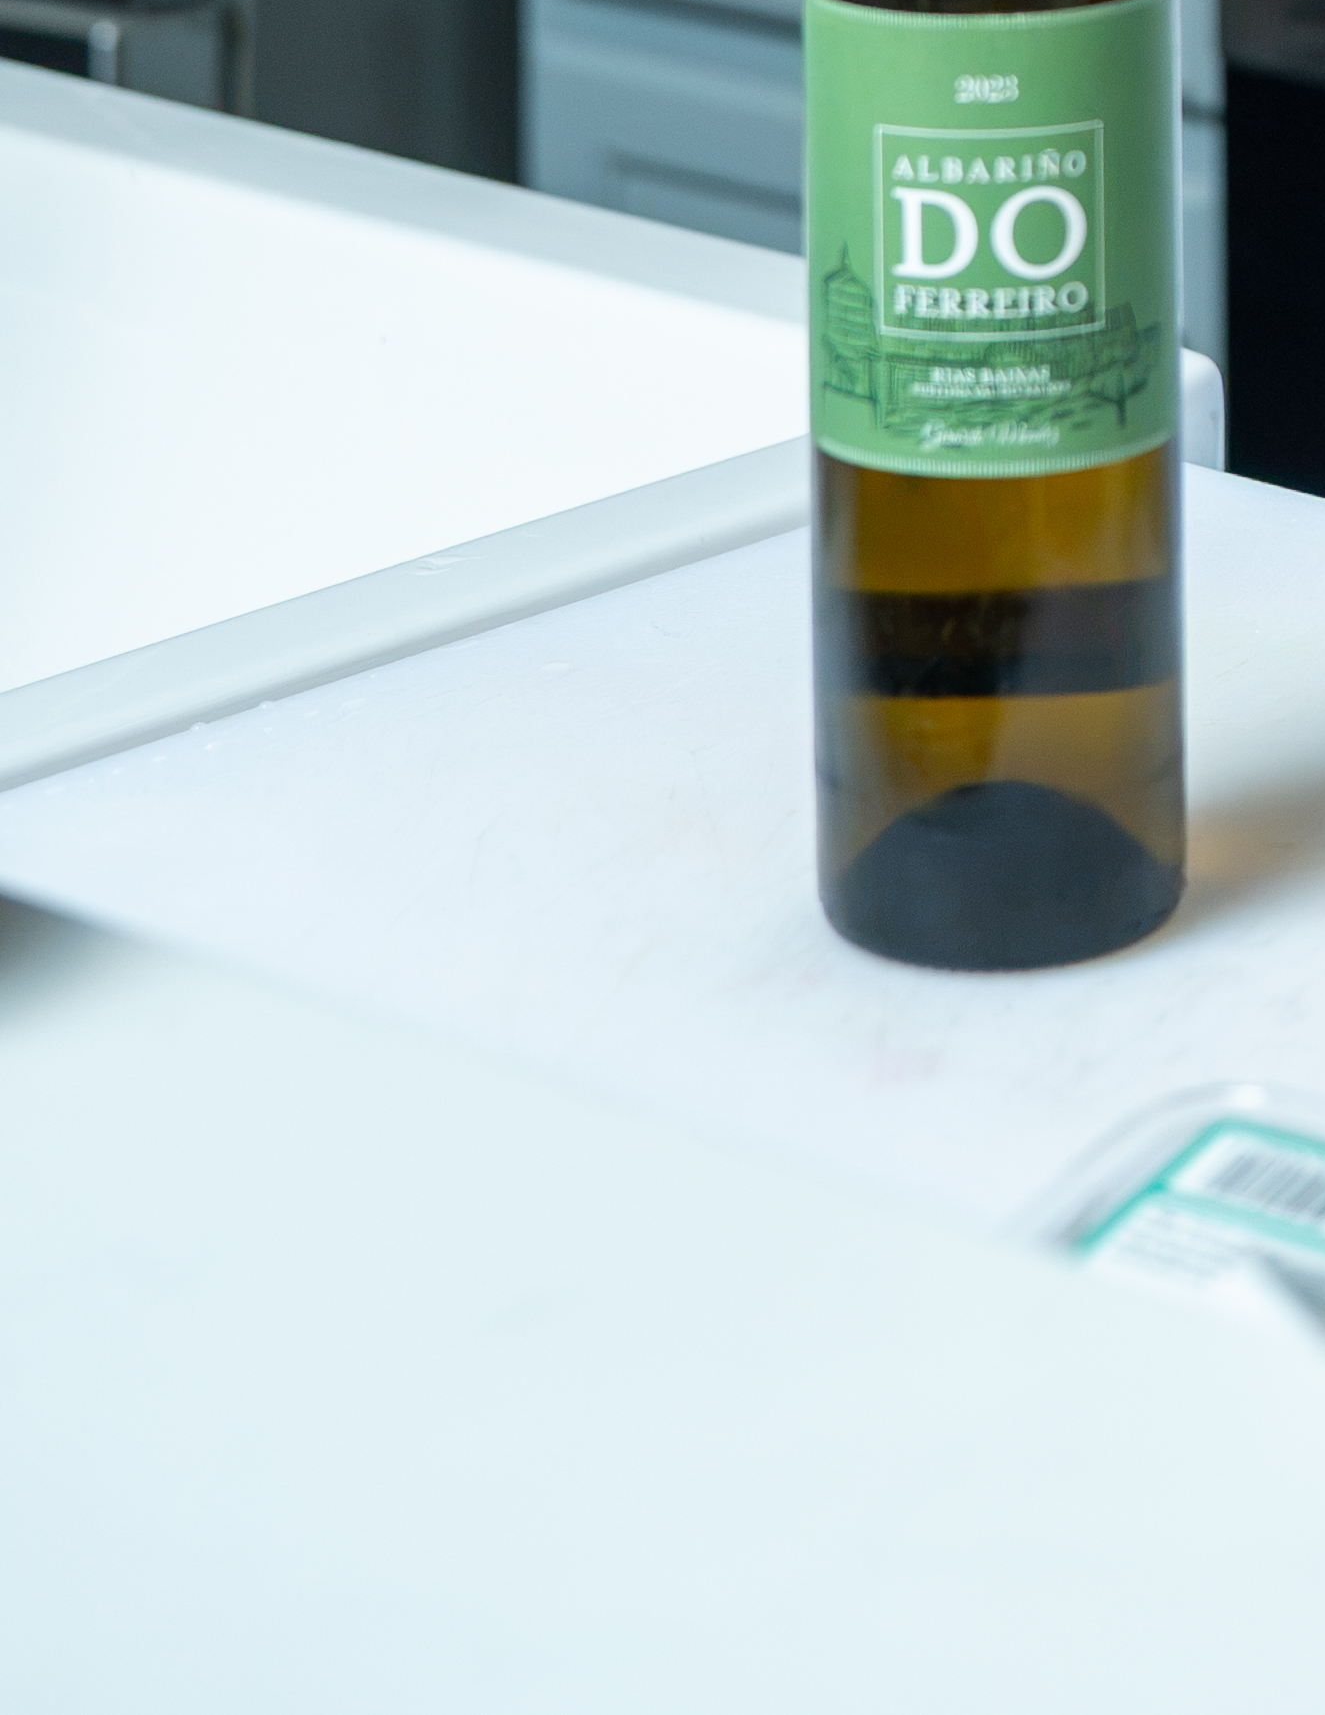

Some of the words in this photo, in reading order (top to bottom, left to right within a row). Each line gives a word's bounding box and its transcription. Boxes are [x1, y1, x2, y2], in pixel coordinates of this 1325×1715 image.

[891, 148, 1086, 185] ALBARIÑO
[891, 185, 1088, 280] DO
[893, 281, 1088, 319] FERREIRO
